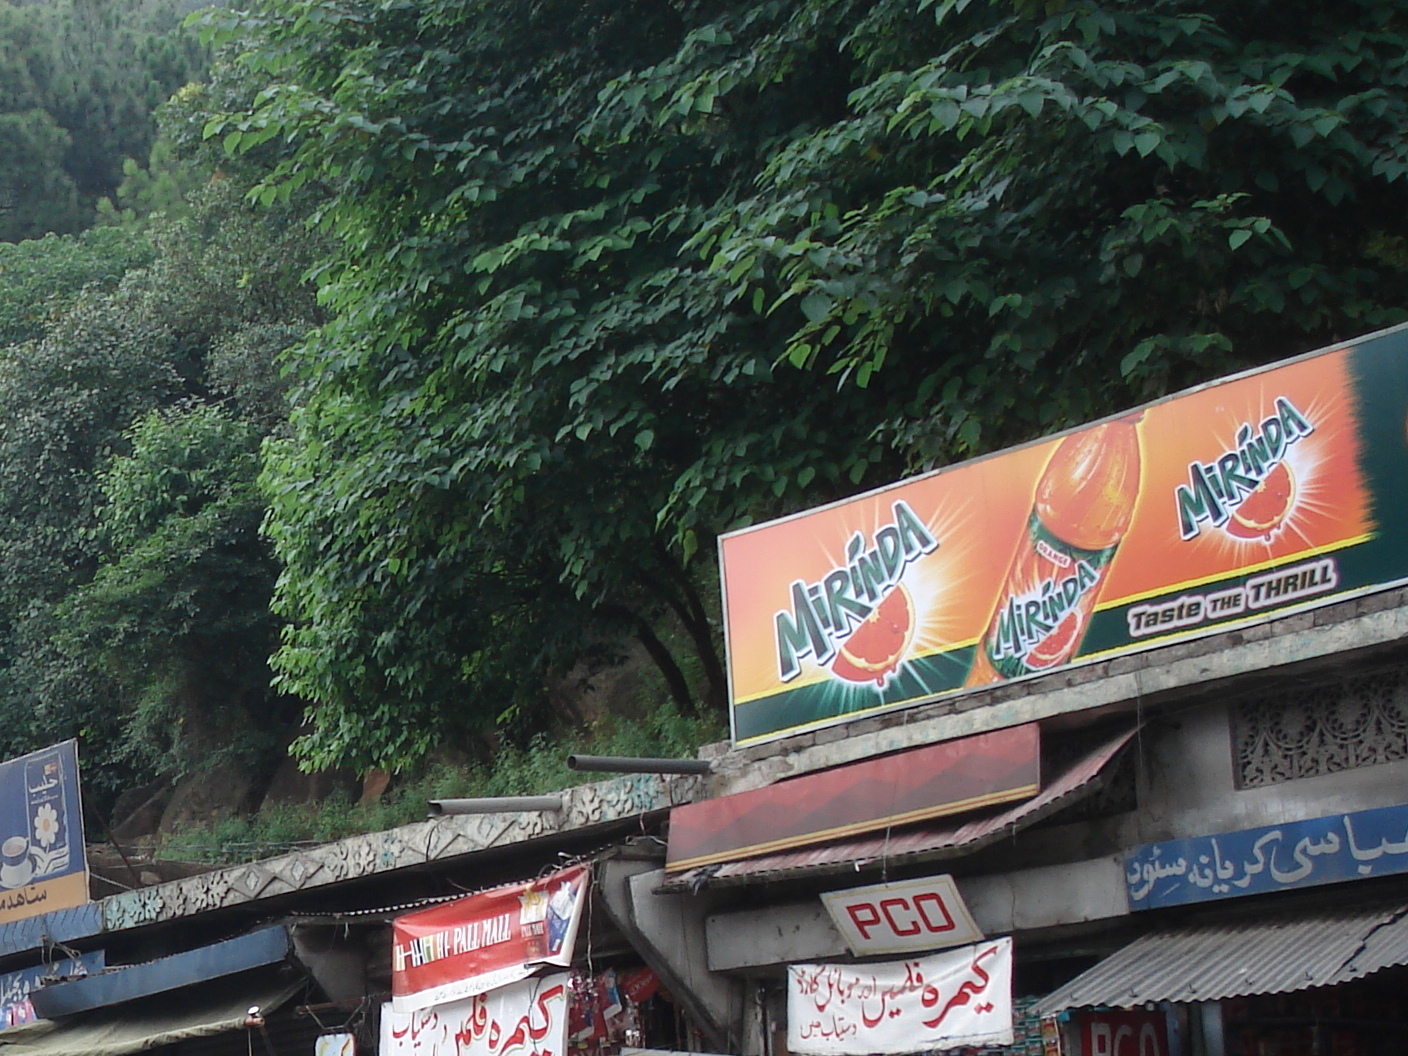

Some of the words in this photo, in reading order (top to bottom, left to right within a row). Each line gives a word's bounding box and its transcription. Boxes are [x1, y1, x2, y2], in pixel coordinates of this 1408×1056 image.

[1131, 600, 1201, 630] Taste
[1209, 592, 1242, 613] THE
[1248, 564, 1332, 603] THRILL
[453, 922, 481, 956] PALL
[481, 913, 511, 948] MALL
[846, 892, 956, 940] PCO
[921, 946, 998, 1028] کیمرہ
